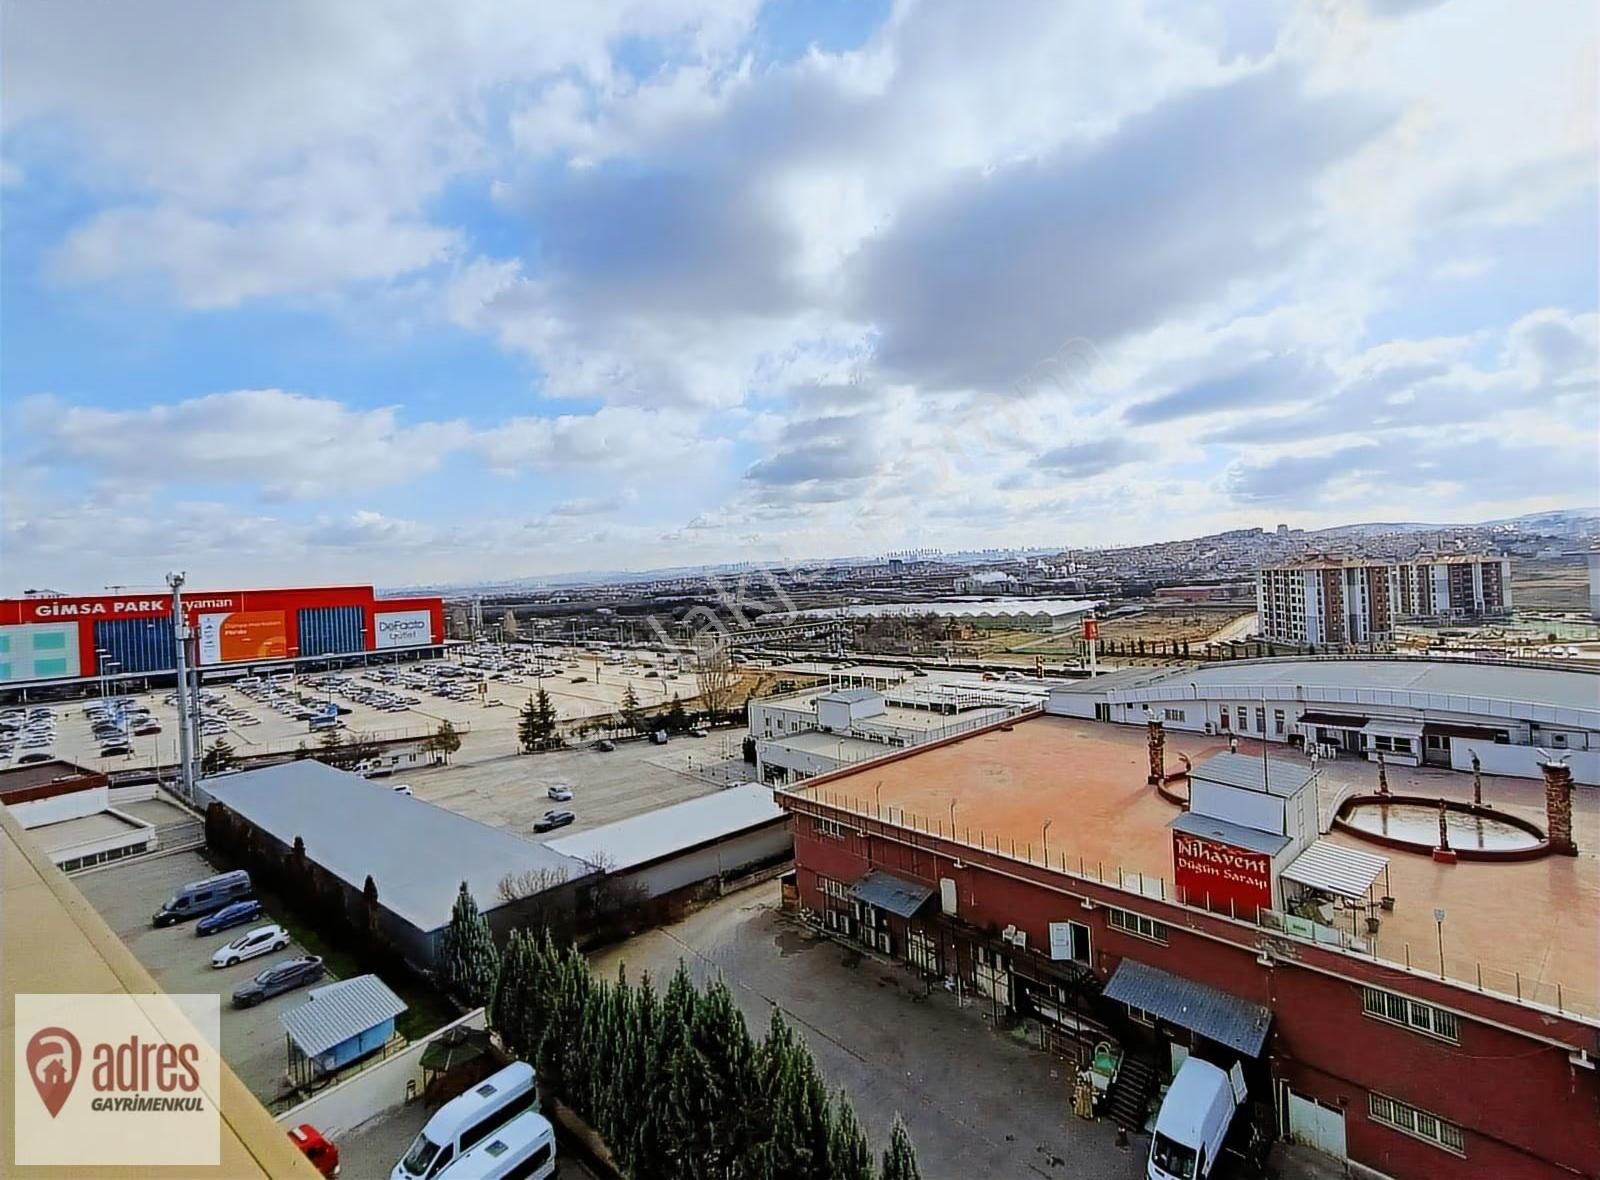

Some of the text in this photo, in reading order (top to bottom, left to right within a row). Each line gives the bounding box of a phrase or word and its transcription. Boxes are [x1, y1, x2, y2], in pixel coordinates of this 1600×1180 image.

[35, 602, 106, 617] GİMSA
[113, 600, 164, 613] PARK
[1176, 840, 1267, 873] Nihavent
